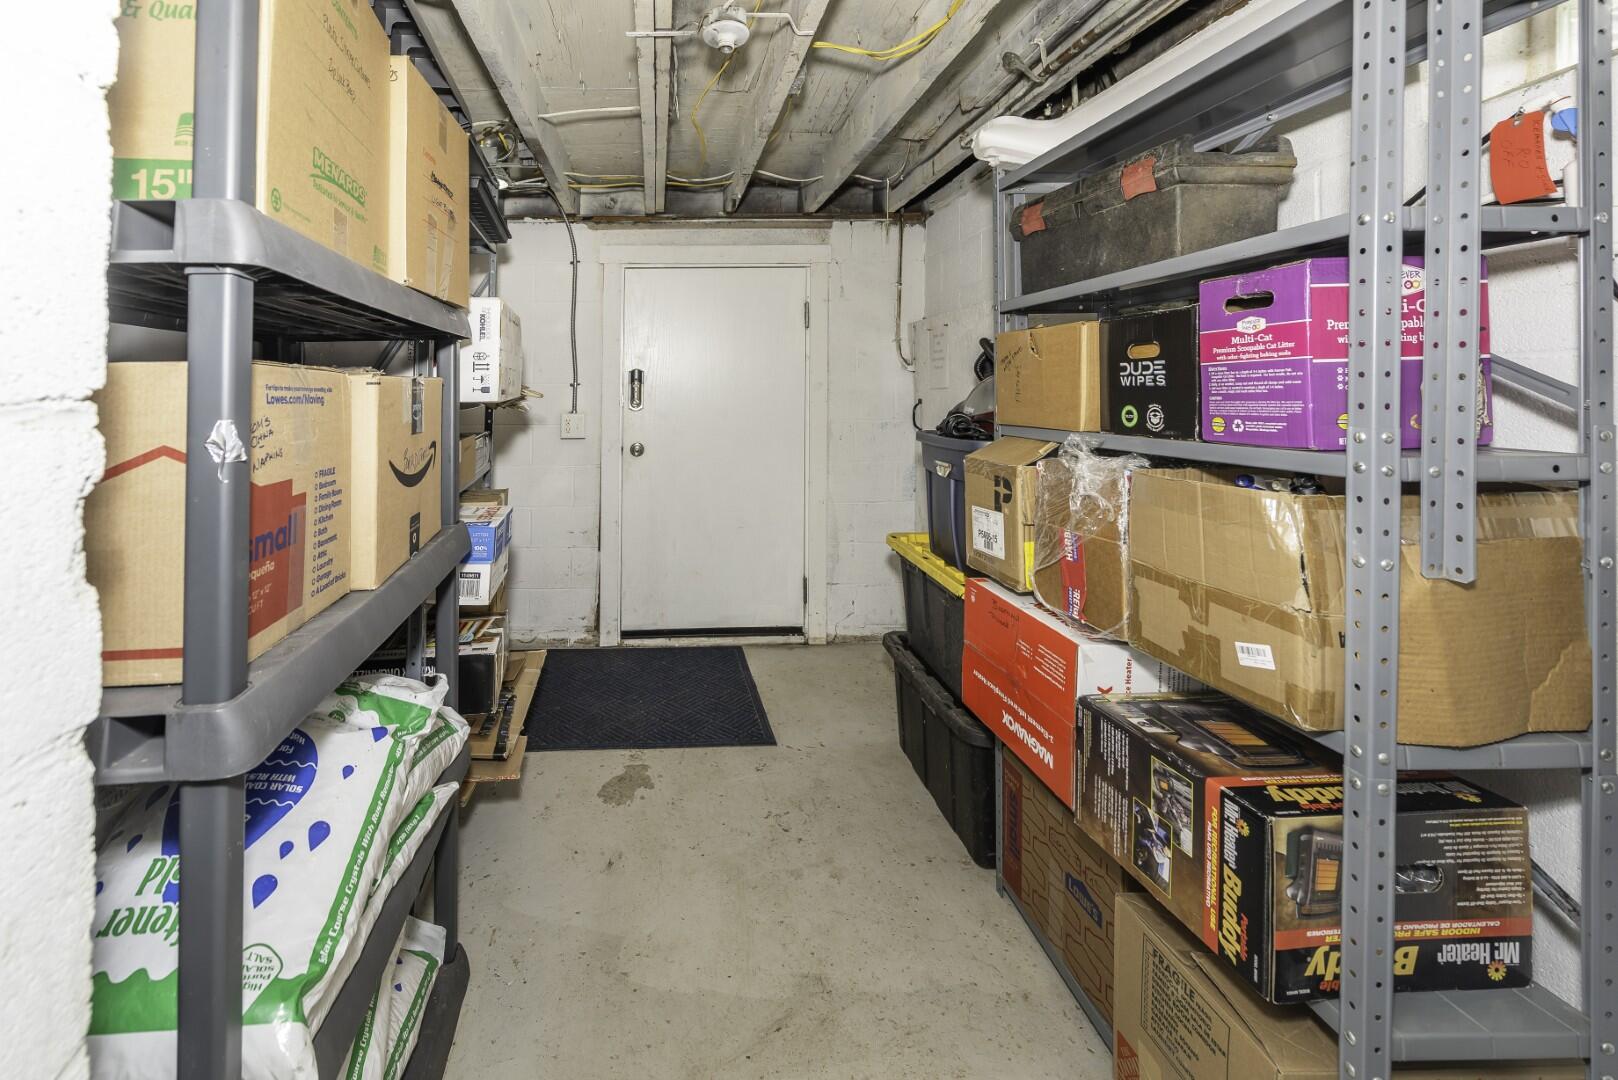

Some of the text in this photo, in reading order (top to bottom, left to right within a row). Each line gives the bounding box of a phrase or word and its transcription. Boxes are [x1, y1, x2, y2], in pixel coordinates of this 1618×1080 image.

[150, 0, 197, 21] Qua
[312, 146, 367, 203] MENARDS
[1400, 270, 1422, 280] EVER
[1326, 316, 1425, 333] Pre pabl
[1231, 333, 1273, 345] Multi-Cat
[1337, 335, 1349, 344] wi
[1212, 347, 1236, 355] Premium
[1237, 344, 1265, 353] Scoopable
[1266, 342, 1277, 350] Cat
[1120, 360, 1166, 375] DUDE
[1120, 375, 1166, 387] WIPES
[266, 393, 325, 406] Lowes.com/Moving
[318, 466, 336, 478] FRAGILE
[318, 514, 334, 525] Kitchen
[1064, 527, 1073, 561] HARB
[1073, 589, 1081, 619] REIG
[289, 732, 306, 745] Wat
[1002, 710, 1054, 769] MAGNAVOX
[277, 745, 294, 754] For
[270, 774, 296, 783] WITH
[270, 782, 304, 793] SOLAR
[1224, 797, 1241, 870] Mr. Heater
[328, 896, 349, 937] Coarse
[345, 850, 365, 895] Crystals
[361, 824, 375, 850] With
[371, 800, 383, 825] Rust
[1210, 827, 1218, 907] RECREATIONAL
[1218, 863, 1242, 967] Buddy
[1402, 922, 1439, 930] PROPANO
[1451, 920, 1501, 929] CALENTADOR
[1413, 929, 1440, 937] SAFE
[1441, 927, 1481, 936] INDOOR
[245, 951, 273, 964] SALT
[1437, 942, 1521, 965] Mr. Heater
[242, 965, 274, 973] SOLA
[1152, 947, 1195, 1004] FRAGILE
[1320, 980, 1340, 992] ble
[352, 1048, 364, 1080] oarse
[360, 1010, 373, 1048] Crystals
